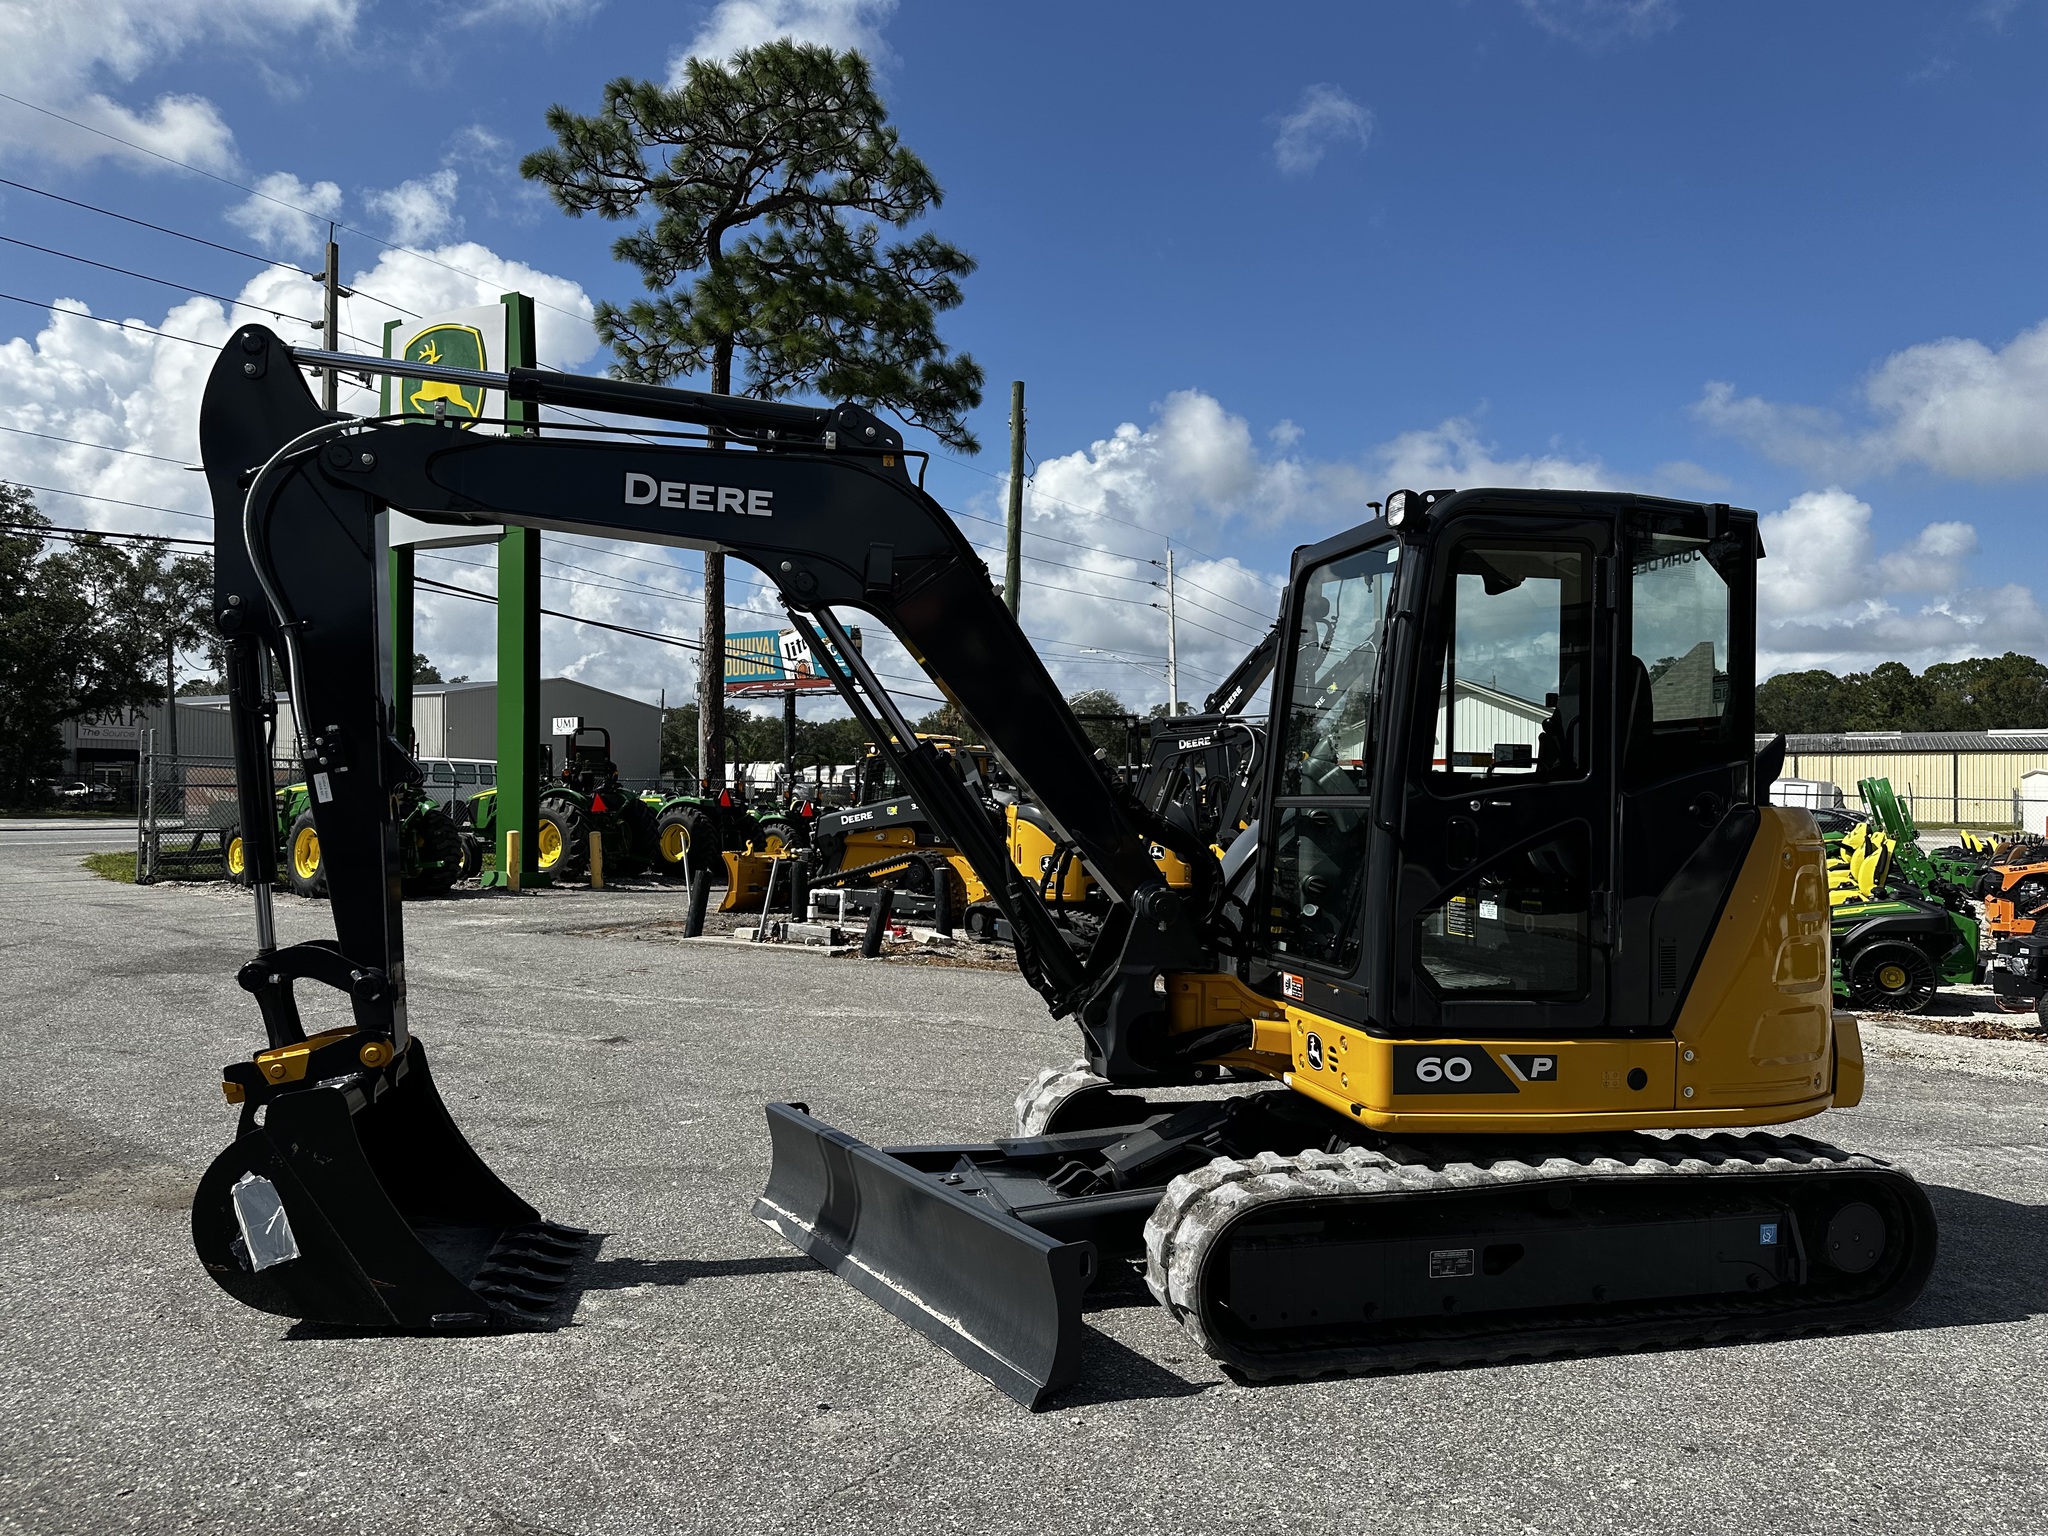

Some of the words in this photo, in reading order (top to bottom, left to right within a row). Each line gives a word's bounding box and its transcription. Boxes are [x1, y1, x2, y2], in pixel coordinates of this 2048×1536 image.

[625, 472, 773, 517] DEERE
[725, 636, 776, 657] DUUUVAL
[1219, 685, 1243, 714] DEERE
[556, 718, 575, 728] UMI
[82, 728, 100, 737] The
[102, 729, 135, 738] Source
[1178, 737, 1211, 749] DEERE
[840, 811, 873, 825] DEERE
[1416, 1056, 1472, 1083] 60
[1530, 1057, 1553, 1078] P
